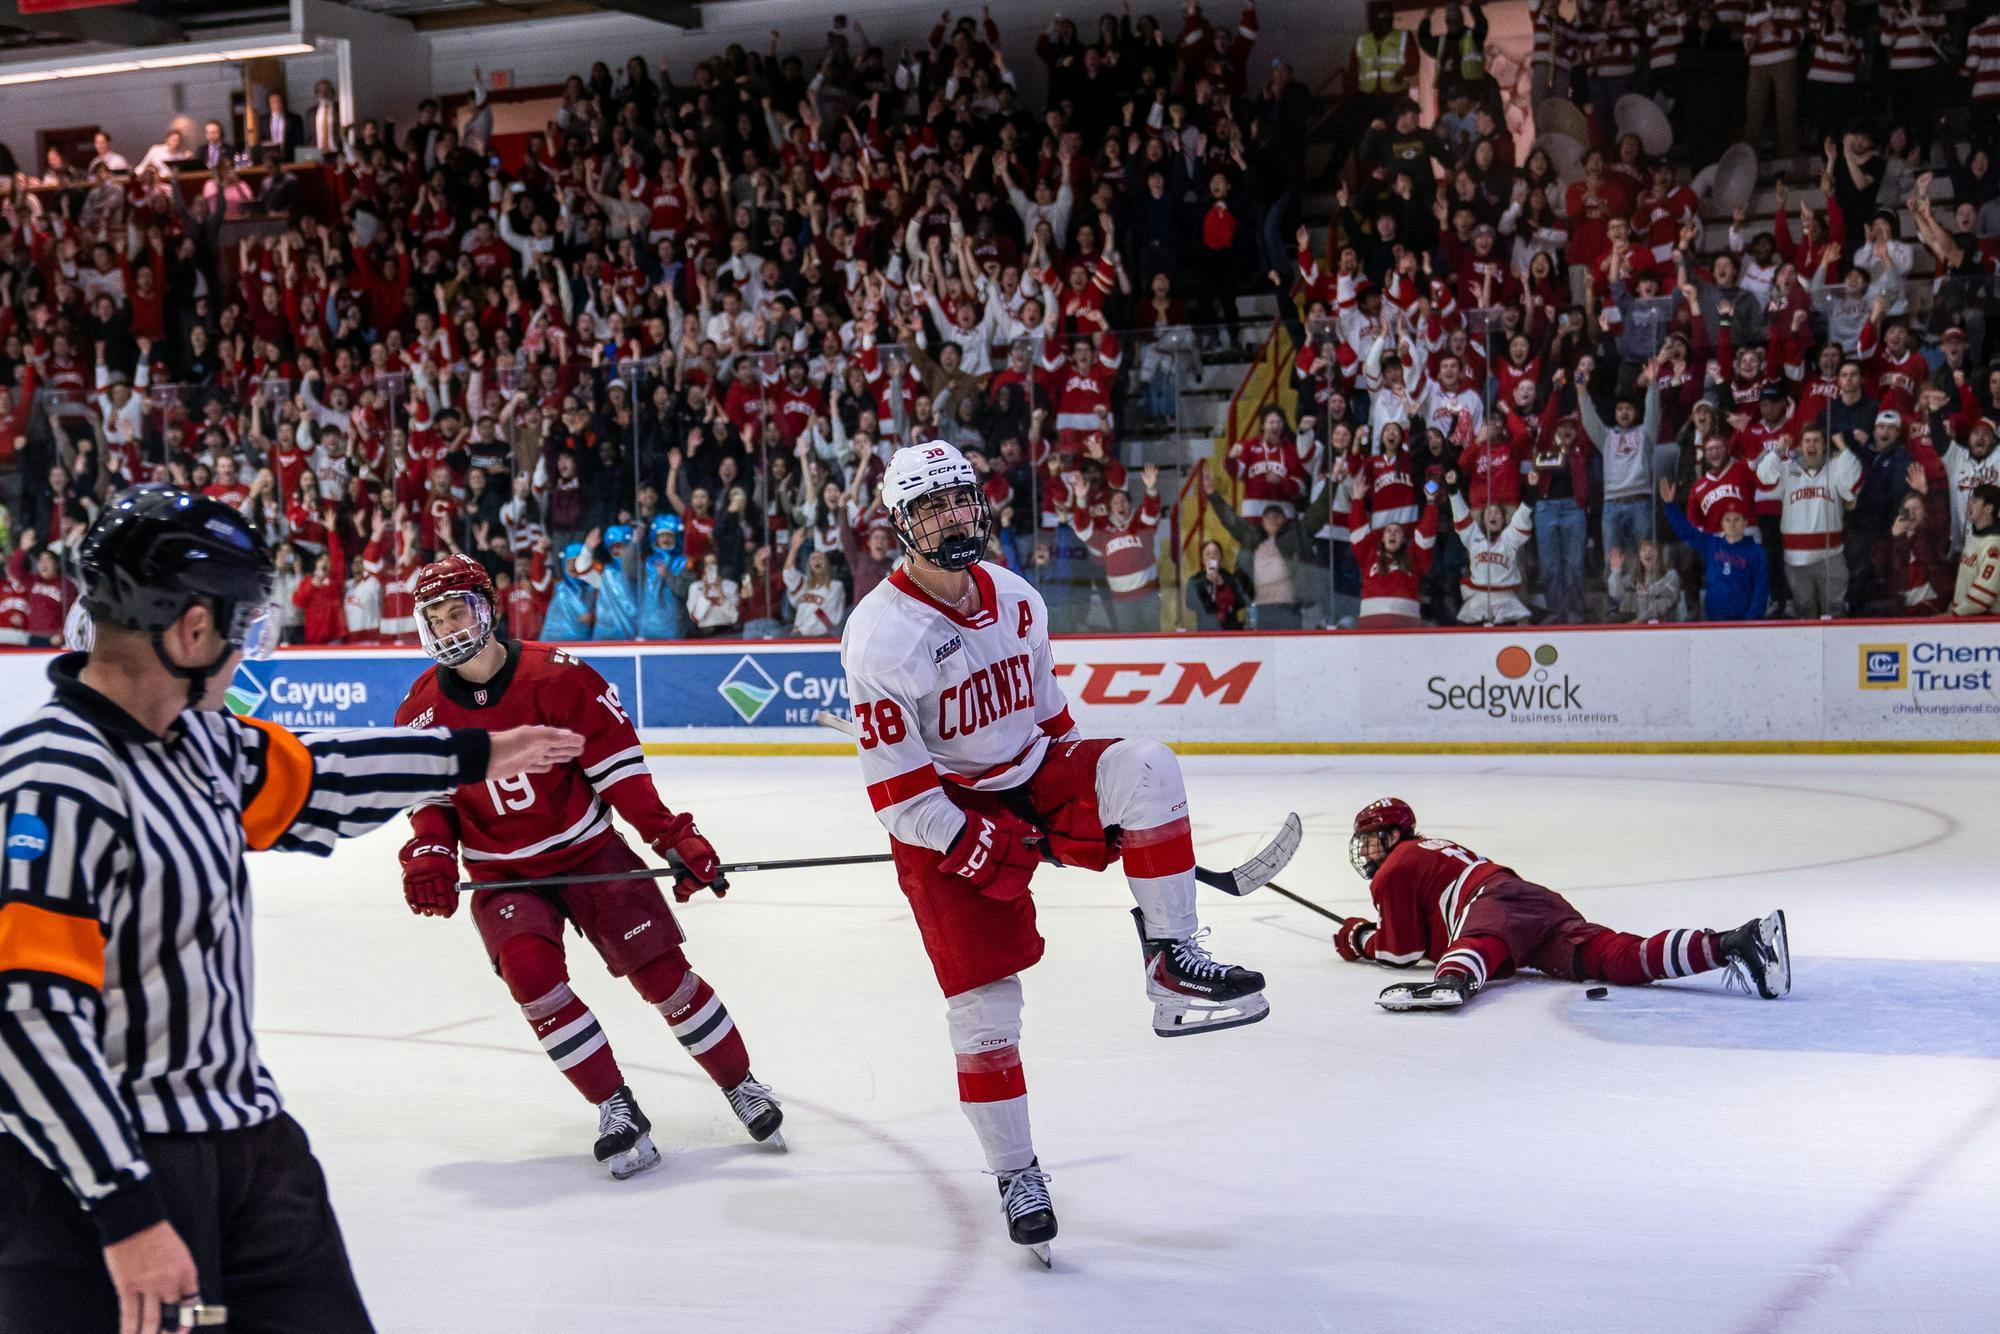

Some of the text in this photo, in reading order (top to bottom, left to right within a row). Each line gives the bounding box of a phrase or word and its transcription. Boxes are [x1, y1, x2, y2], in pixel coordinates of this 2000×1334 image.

[922, 447, 946, 460] 38
[928, 465, 957, 476] CCM
[1790, 486, 1834, 504] CORNELL
[951, 549, 976, 559] CCM
[1982, 565, 1995, 580] 8
[420, 581, 441, 593] CCM
[1017, 600, 1033, 638] A
[935, 634, 961, 658] ECAC
[1912, 642, 2000, 663] Chem
[783, 671, 850, 707] Cayu
[1055, 661, 1262, 705] CM
[1912, 670, 1991, 690] Trust
[270, 676, 367, 710] Cayuga
[938, 654, 1036, 741] CORNEL
[1427, 674, 1583, 718] Sedgwick
[272, 711, 336, 726] HEALTH
[854, 698, 907, 750] 38
[1511, 712, 1619, 723] business interiors
[485, 772, 536, 815] 19
[956, 817, 996, 878] CCM
[624, 920, 651, 941] CCM
[1179, 980, 1213, 993] BAUER
[671, 1004, 691, 1018] CCM
[981, 1038, 1008, 1047] CCM
